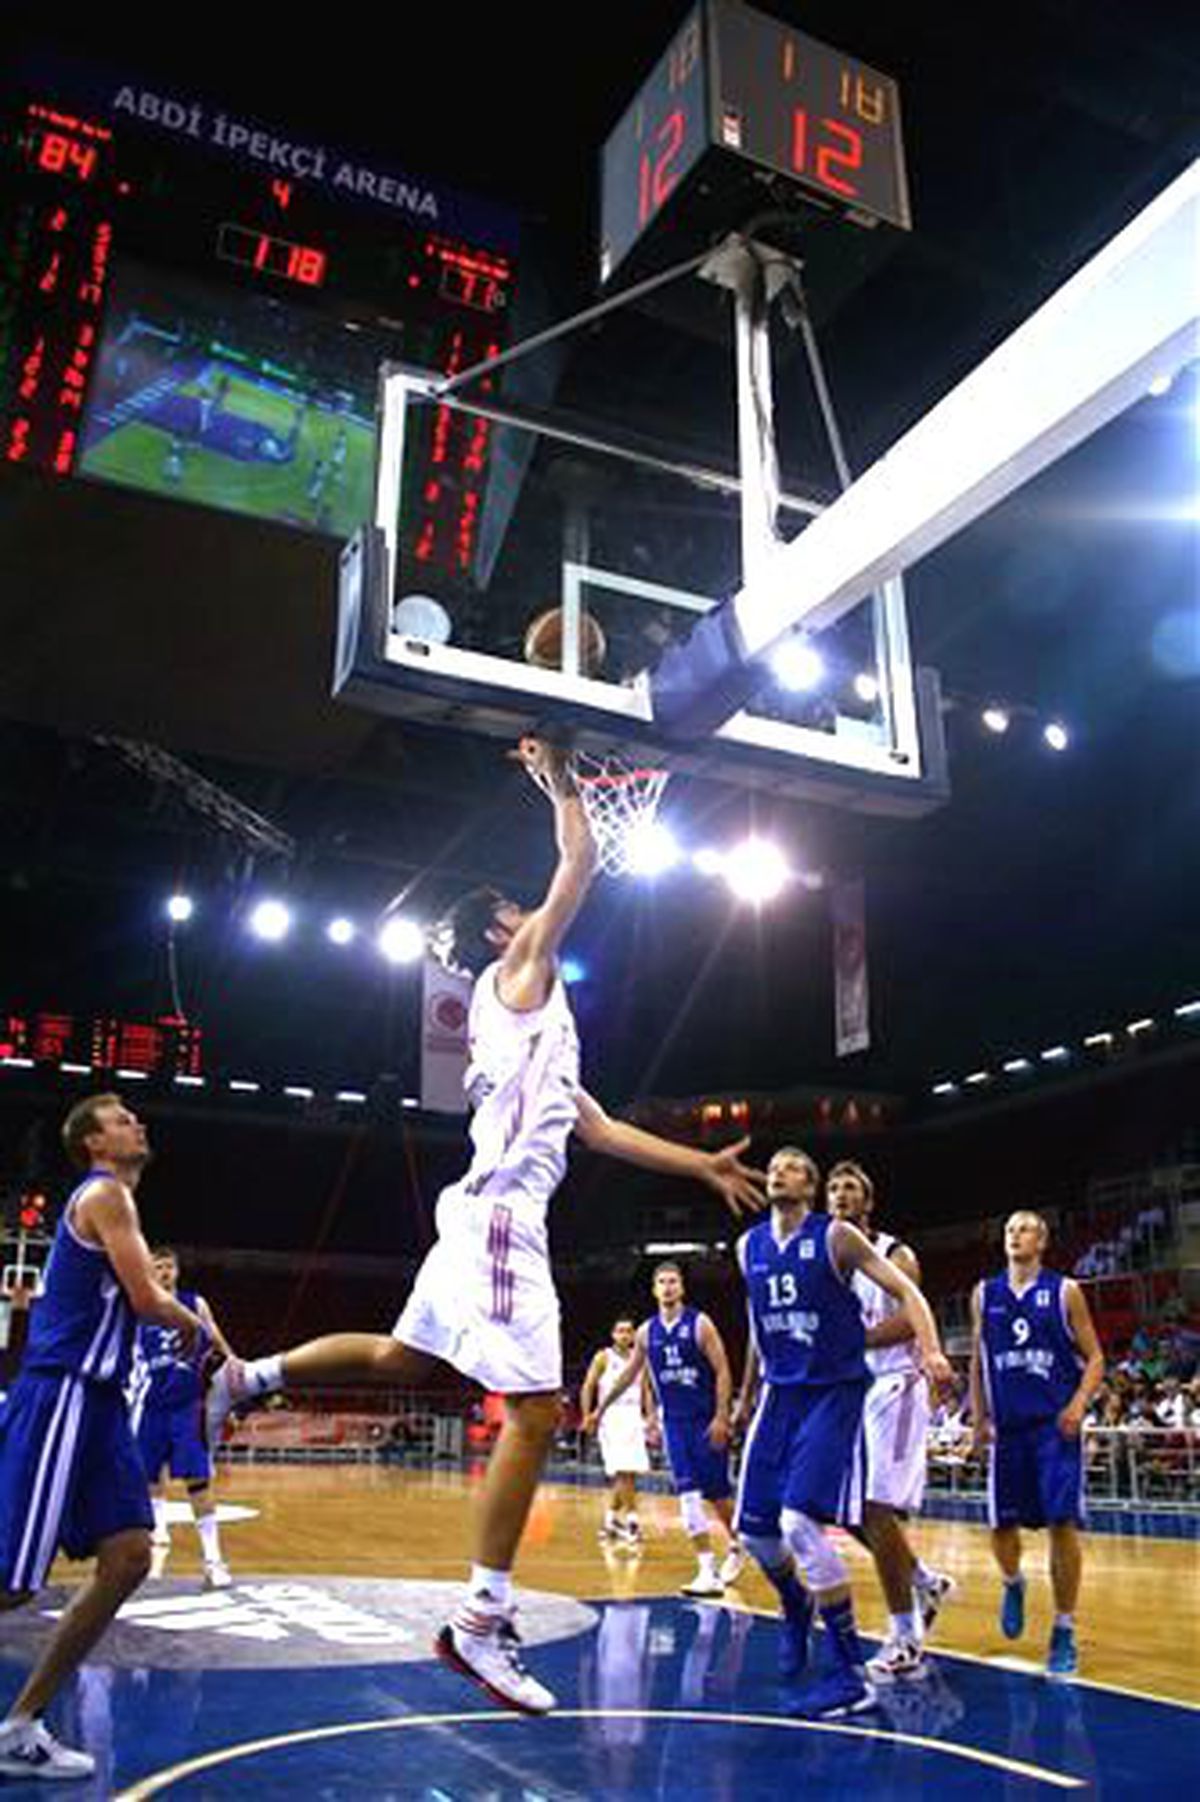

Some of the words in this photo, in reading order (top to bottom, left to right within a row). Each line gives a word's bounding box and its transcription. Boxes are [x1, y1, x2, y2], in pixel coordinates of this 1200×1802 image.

[784, 39, 794, 82] 1
[39, 131, 97, 181] 84
[113, 85, 203, 138] ABDİ
[211, 115, 327, 180] İPEKÇİ
[332, 163, 439, 220] ARENA
[636, 112, 685, 232] 12
[791, 105, 863, 198] 12
[272, 179, 290, 209] 4
[287, 245, 325, 286] 18
[766, 1273, 798, 1307] 13
[1011, 1317, 1030, 1346] 9
